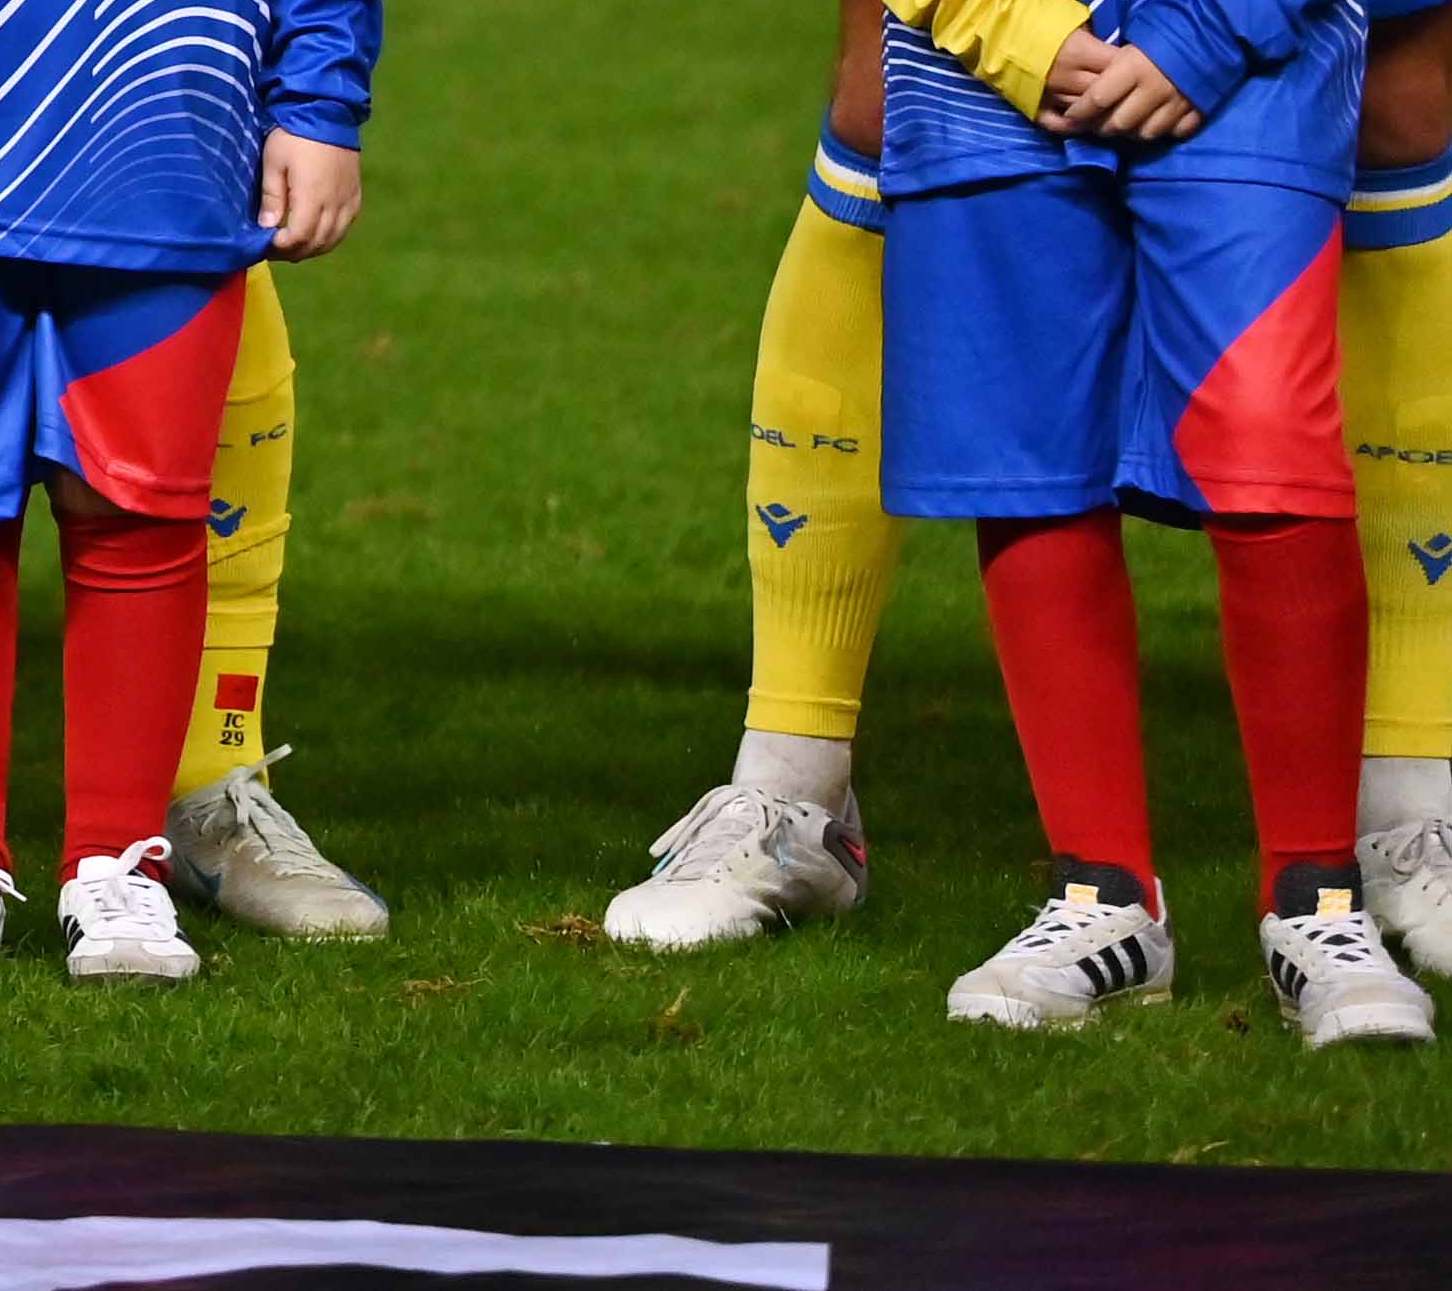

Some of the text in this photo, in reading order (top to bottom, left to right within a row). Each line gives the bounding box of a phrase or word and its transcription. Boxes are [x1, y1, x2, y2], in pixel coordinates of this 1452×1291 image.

[249, 422, 286, 448] FC
[811, 433, 859, 454] FC
[219, 731, 245, 747] 29
